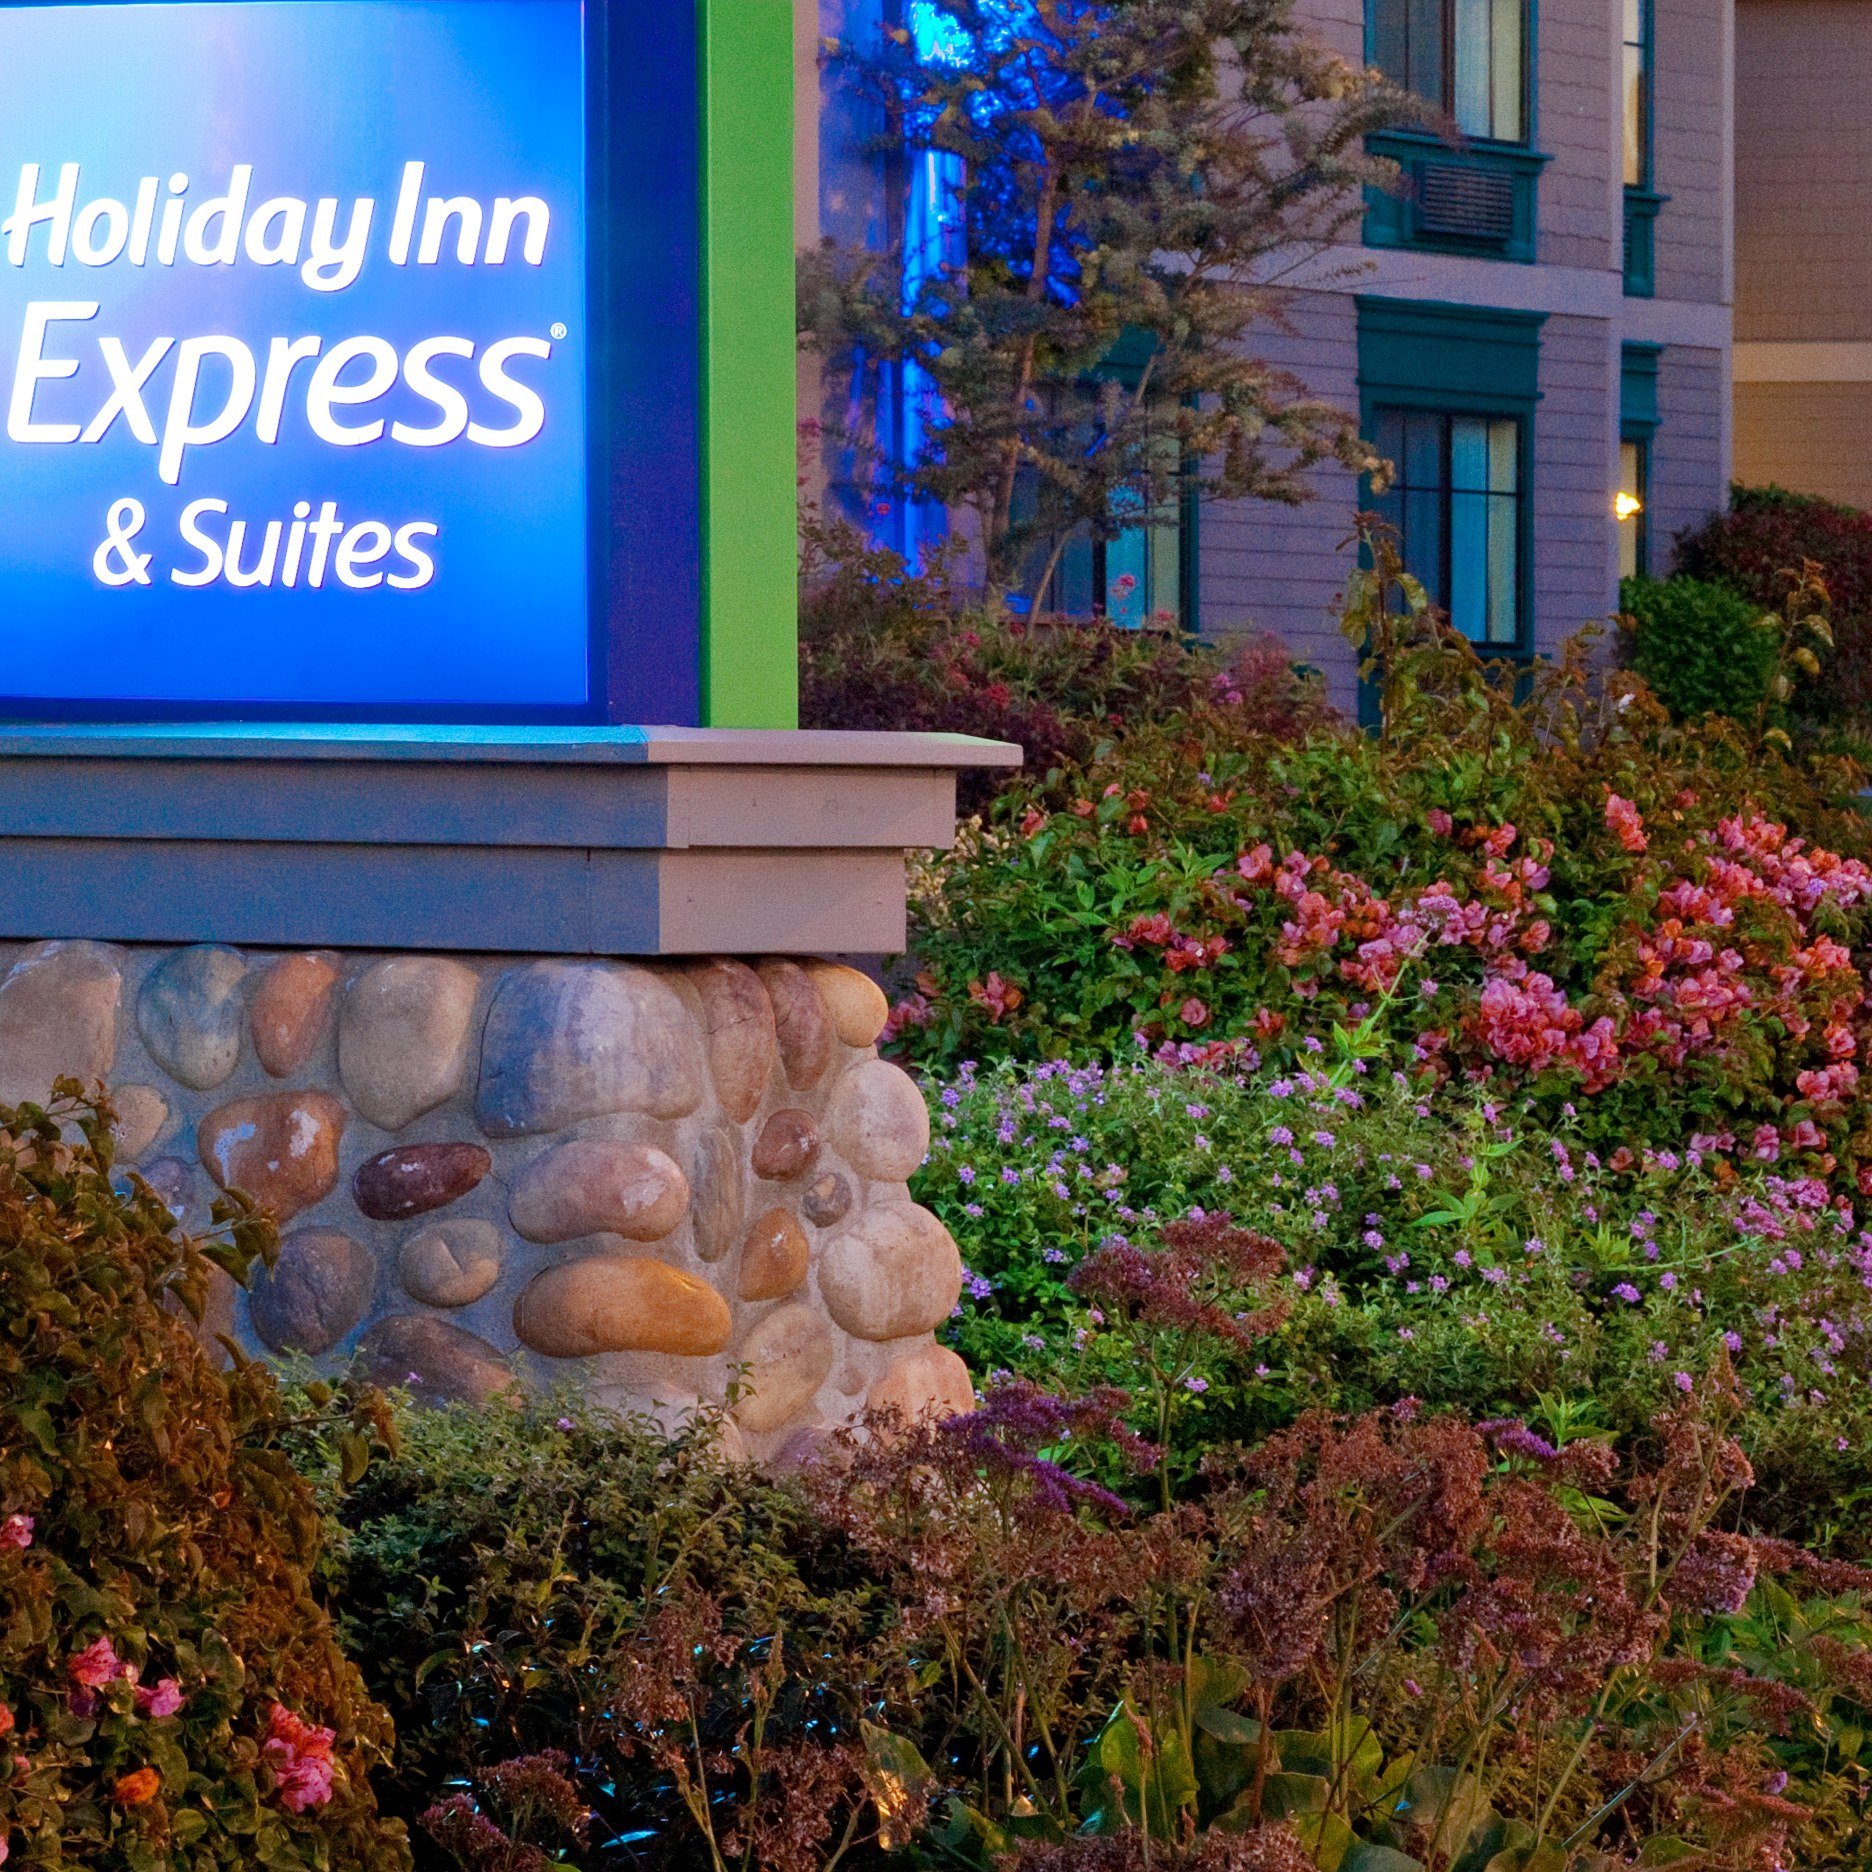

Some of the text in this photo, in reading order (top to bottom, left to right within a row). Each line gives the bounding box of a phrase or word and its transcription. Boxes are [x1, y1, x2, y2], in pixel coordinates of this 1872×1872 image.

[0, 161, 551, 292] Holiday Inn
[92, 497, 439, 589] & Suites
